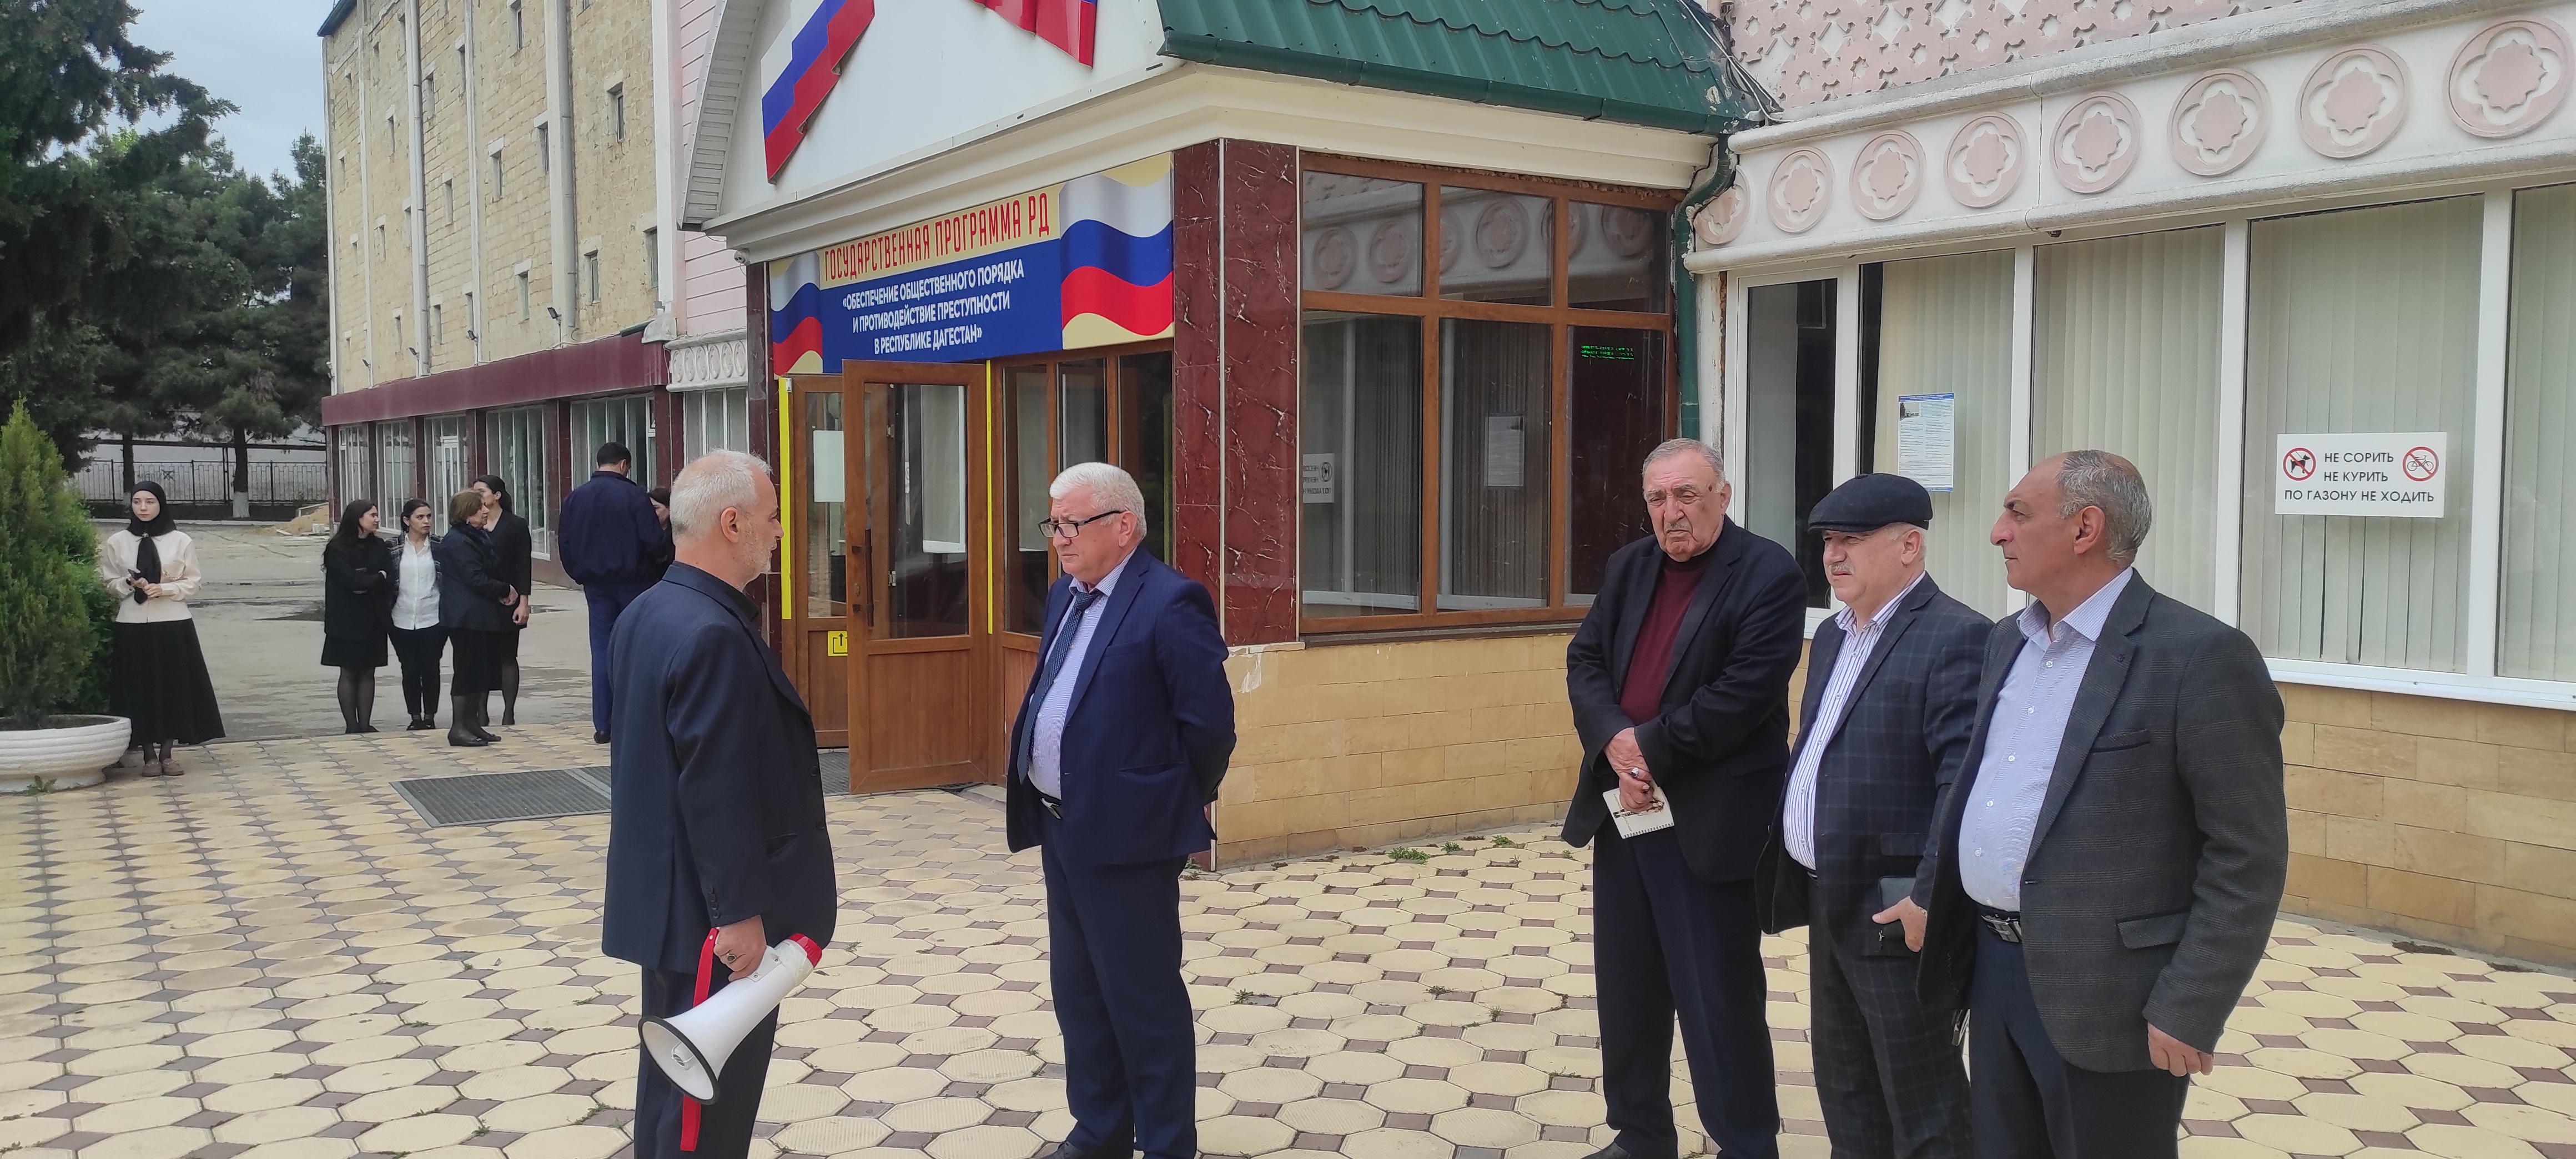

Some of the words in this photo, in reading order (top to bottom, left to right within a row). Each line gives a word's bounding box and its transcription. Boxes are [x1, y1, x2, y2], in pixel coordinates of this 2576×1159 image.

[824, 224, 930, 281] ГОСУДАРСТВЕННАЯ
[935, 200, 1021, 257] ПРОГРАММА
[1028, 192, 1050, 238] РД
[843, 284, 899, 310] «ОБЕСПЕЧЕНИЕ
[899, 269, 975, 301] ОБЩЕСТВЕННОГО
[977, 258, 1024, 287] ПОРЯДКА
[853, 316, 858, 333] И
[859, 304, 936, 332] ПРОТИВОДЕЙСТВИЕ
[937, 290, 1010, 321] ПРЕСТУПНОСТИ
[874, 338, 880, 355] В
[880, 331, 932, 354] РЕСПУБЛИКЕ
[932, 324, 983, 351] ДАГЕСТАН»
[2325, 452, 2339, 463] НЕ
[2343, 452, 2394, 463] СОРИТЬ
[2324, 472, 2339, 482] НЕ
[2343, 471, 2388, 482] КУРИТЬ
[2284, 490, 2303, 501] ПО
[2307, 490, 2358, 501] ГАЗОНУ
[2361, 491, 2377, 501] НЕ
[2381, 491, 2434, 503] ХОДИТЬ
